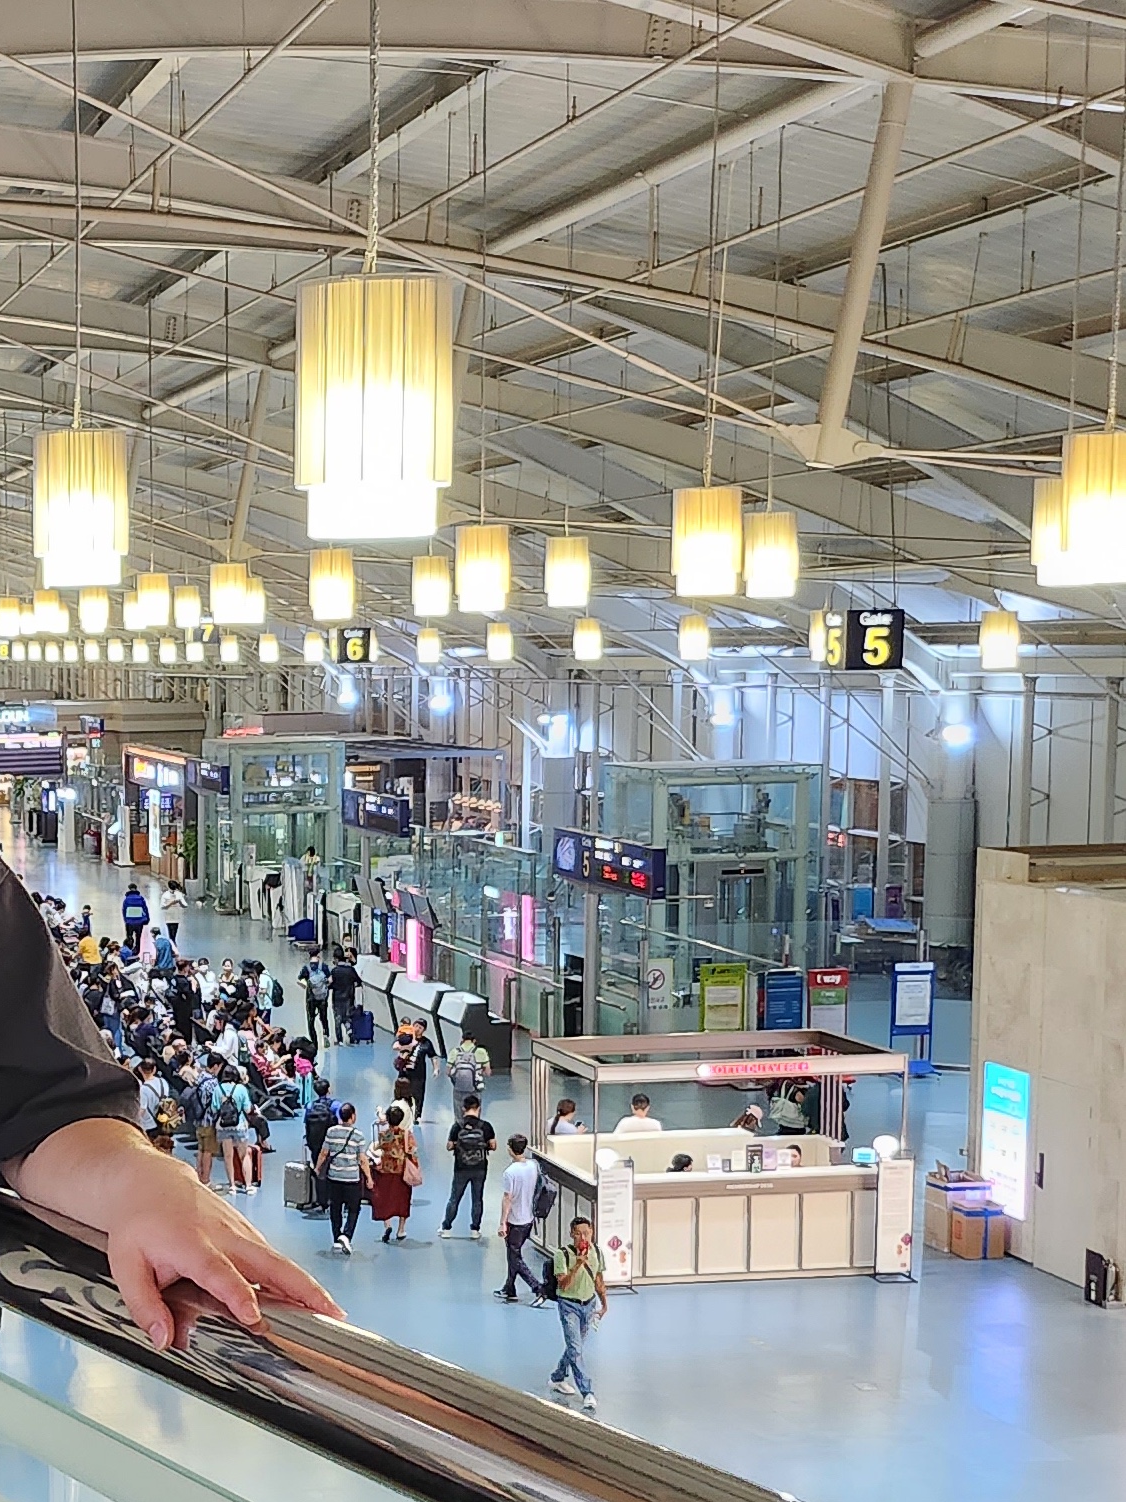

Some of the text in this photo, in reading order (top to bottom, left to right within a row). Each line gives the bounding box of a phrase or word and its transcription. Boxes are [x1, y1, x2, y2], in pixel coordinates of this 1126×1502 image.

[202, 624, 214, 642] 7
[863, 627, 890, 665] 5
[347, 638, 364, 660] 6
[827, 628, 841, 665] 5
[582, 851, 590, 877] 5
